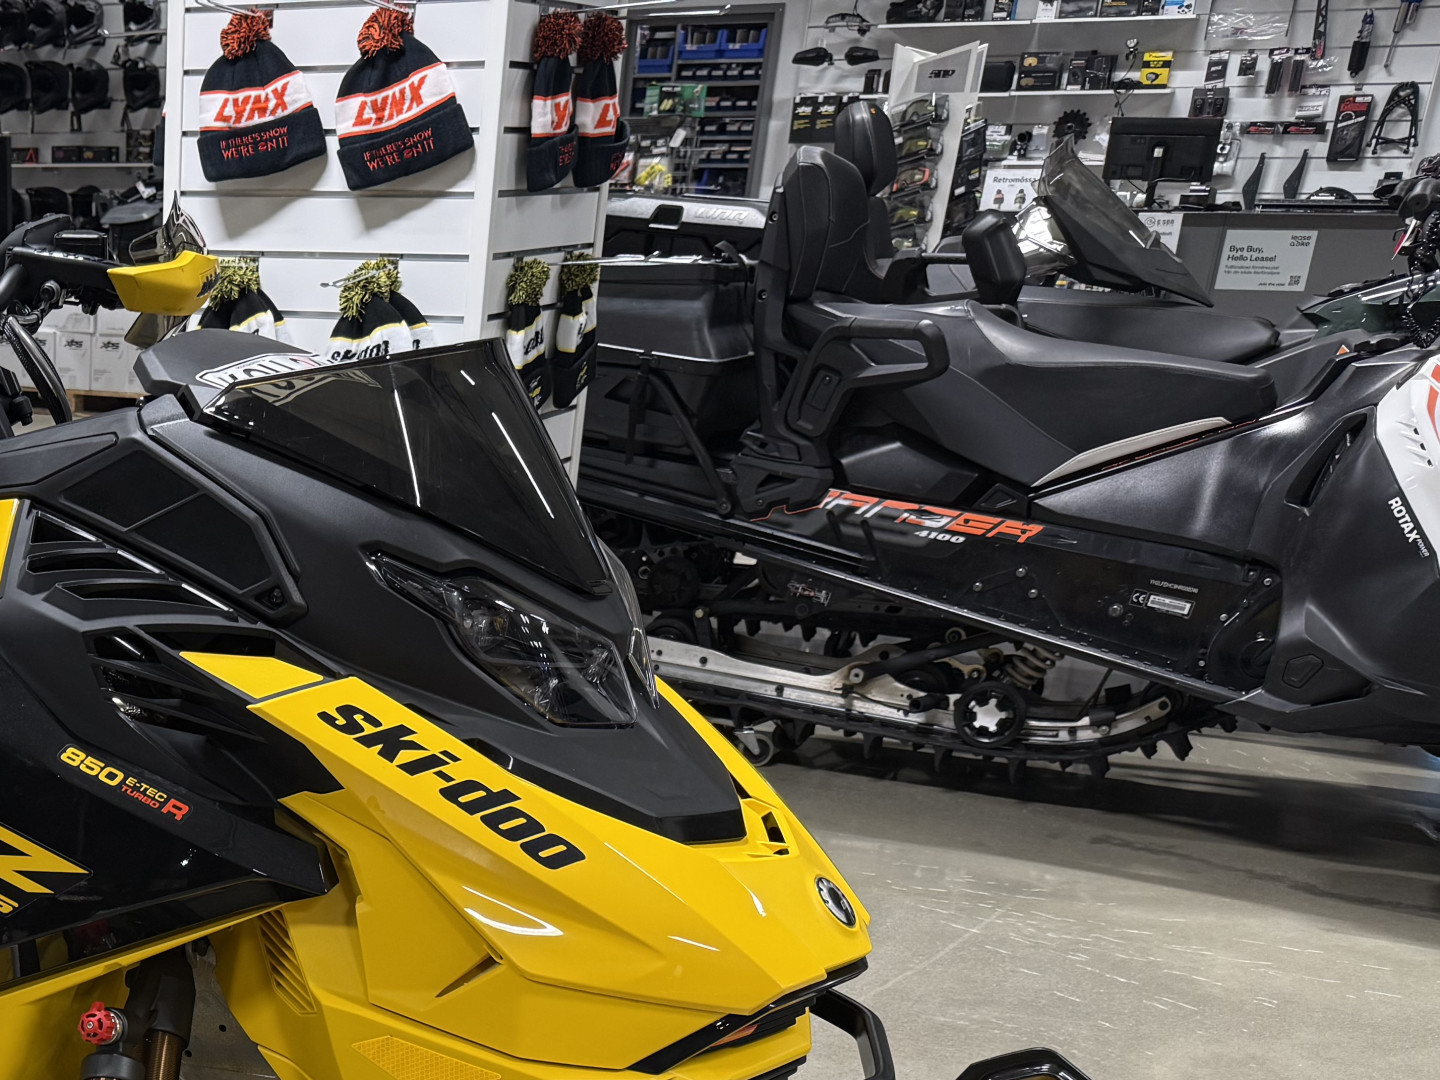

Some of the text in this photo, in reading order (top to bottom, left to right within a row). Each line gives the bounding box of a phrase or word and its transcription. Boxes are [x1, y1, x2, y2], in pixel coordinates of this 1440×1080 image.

[213, 81, 290, 125] LYNX
[351, 74, 428, 127] LYNX
[261, 126, 288, 140] SNOW
[364, 151, 371, 161] IF
[405, 128, 432, 147] SNOW
[222, 144, 255, 160] WE'RE
[367, 151, 401, 171] WE'RE
[1226, 254, 1277, 263] Hello Lease!
[1229, 245, 1264, 253] Bye Buy,
[1387, 496, 1421, 543] ROTAX
[914, 530, 966, 544] 4100
[60, 746, 125, 787] 850
[121, 784, 160, 809] TURBO
[125, 776, 168, 802] E-TEC
[316, 703, 587, 870] ski-doo
